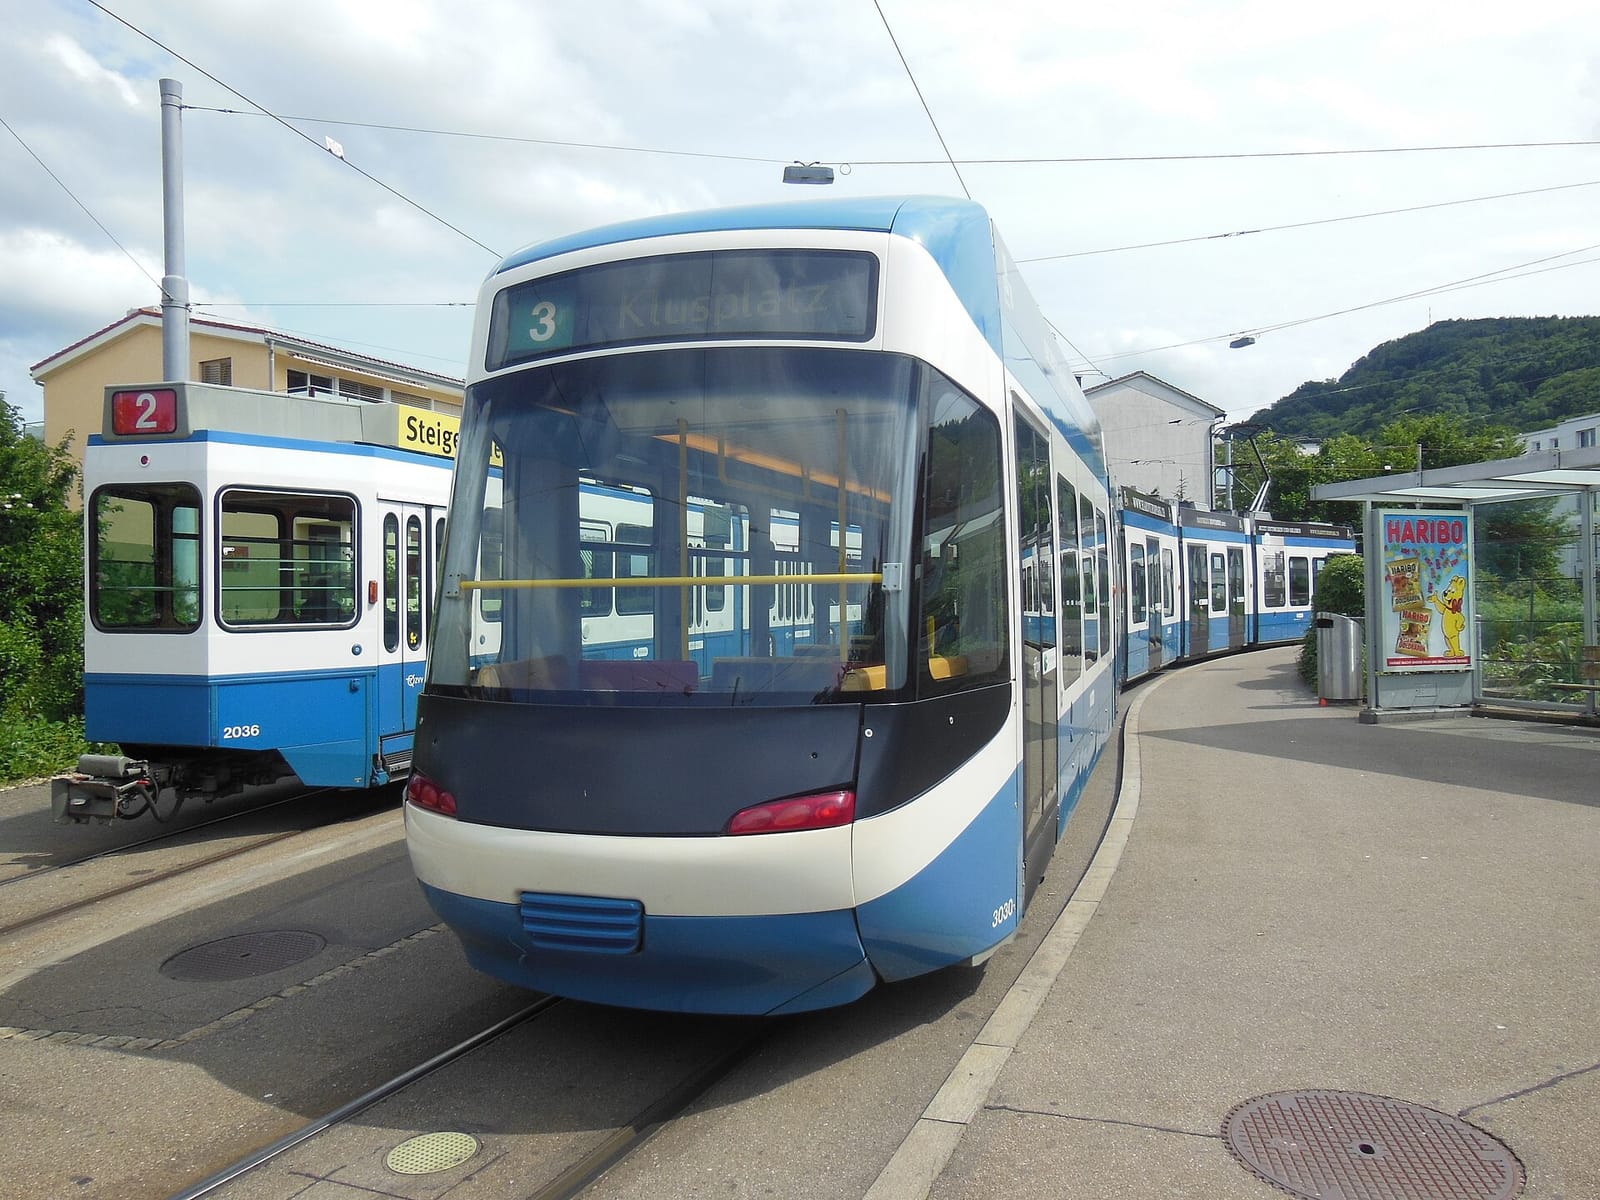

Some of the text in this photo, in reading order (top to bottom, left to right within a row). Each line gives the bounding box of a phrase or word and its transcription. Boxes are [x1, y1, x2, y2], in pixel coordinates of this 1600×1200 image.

[618, 279, 830, 329] Klusplatz
[529, 301, 556, 342] 3
[135, 392, 157, 429] 2
[1387, 519, 1464, 544] HARIBO
[1402, 609, 1429, 624] HARIBO
[223, 724, 260, 739] 2036
[992, 898, 1013, 928] 3030
